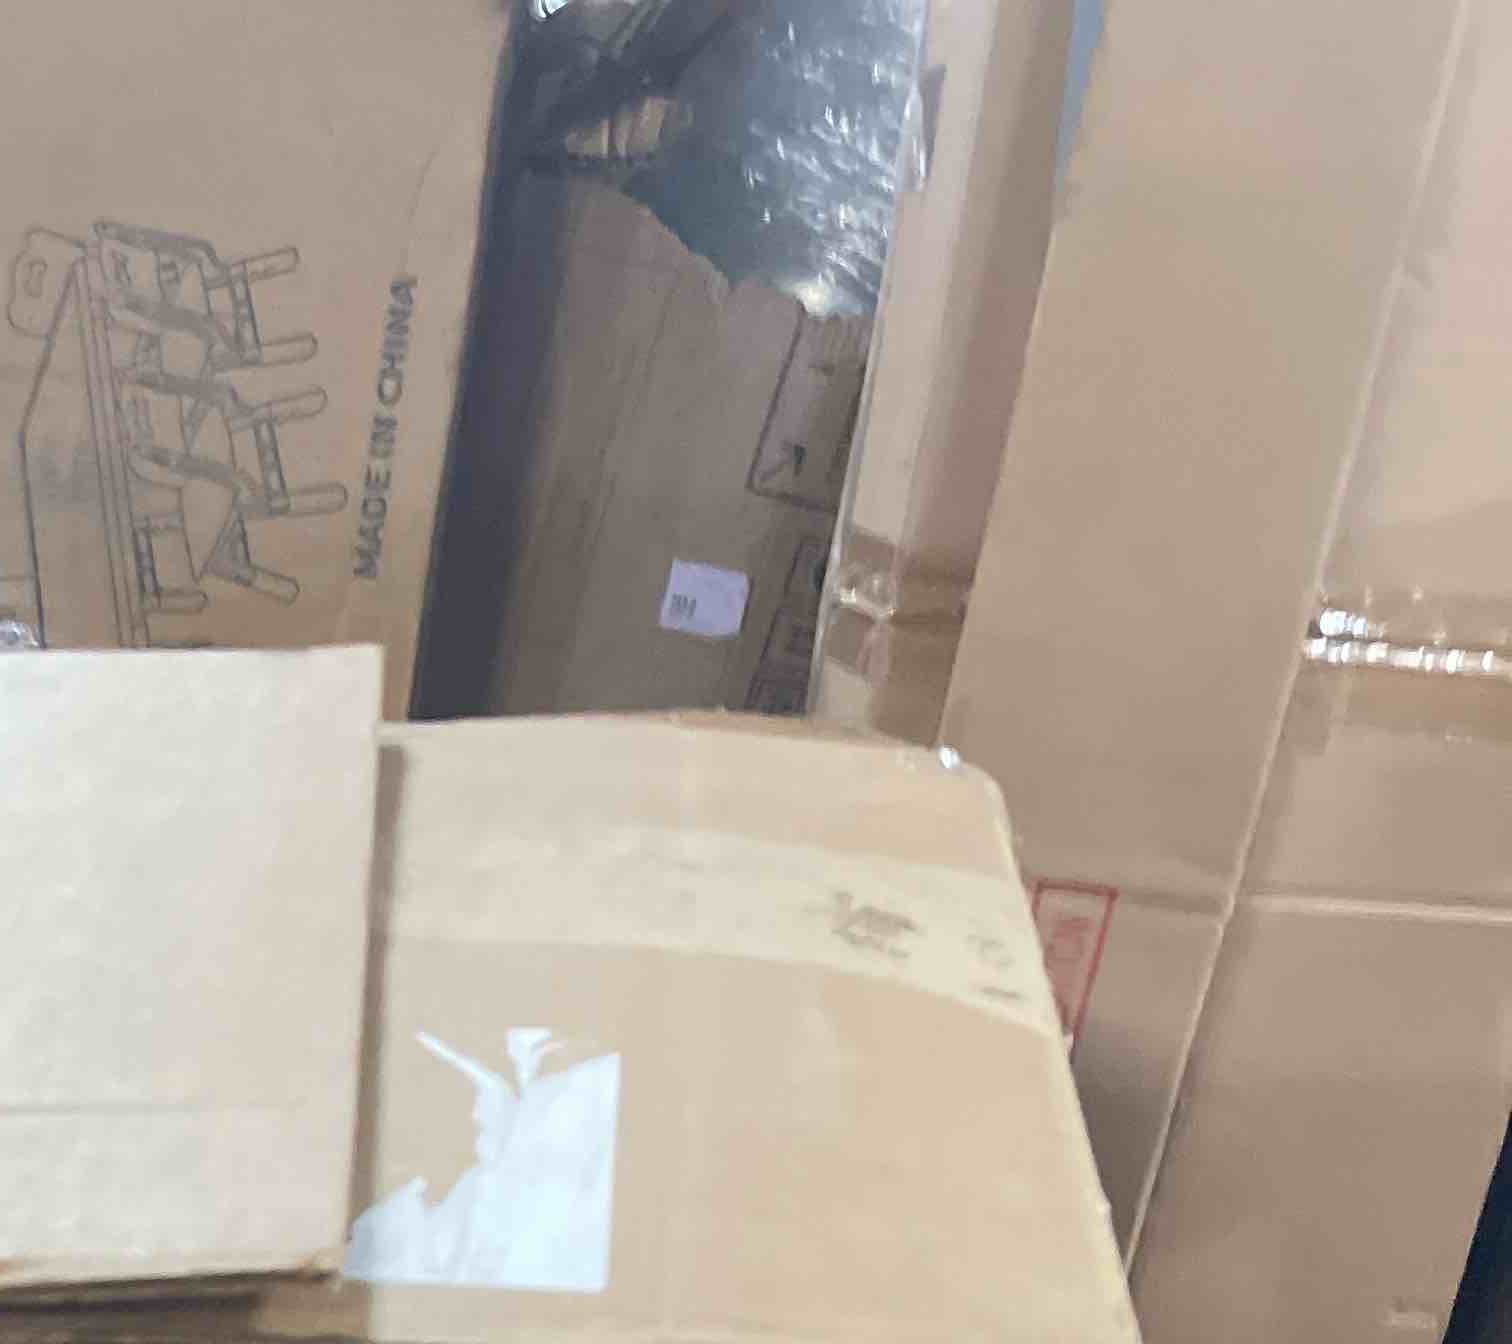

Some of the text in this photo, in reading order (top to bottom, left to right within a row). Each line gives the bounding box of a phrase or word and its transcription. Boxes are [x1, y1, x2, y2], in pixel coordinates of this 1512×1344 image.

[352, 274, 418, 581] MADE IN CHINA
